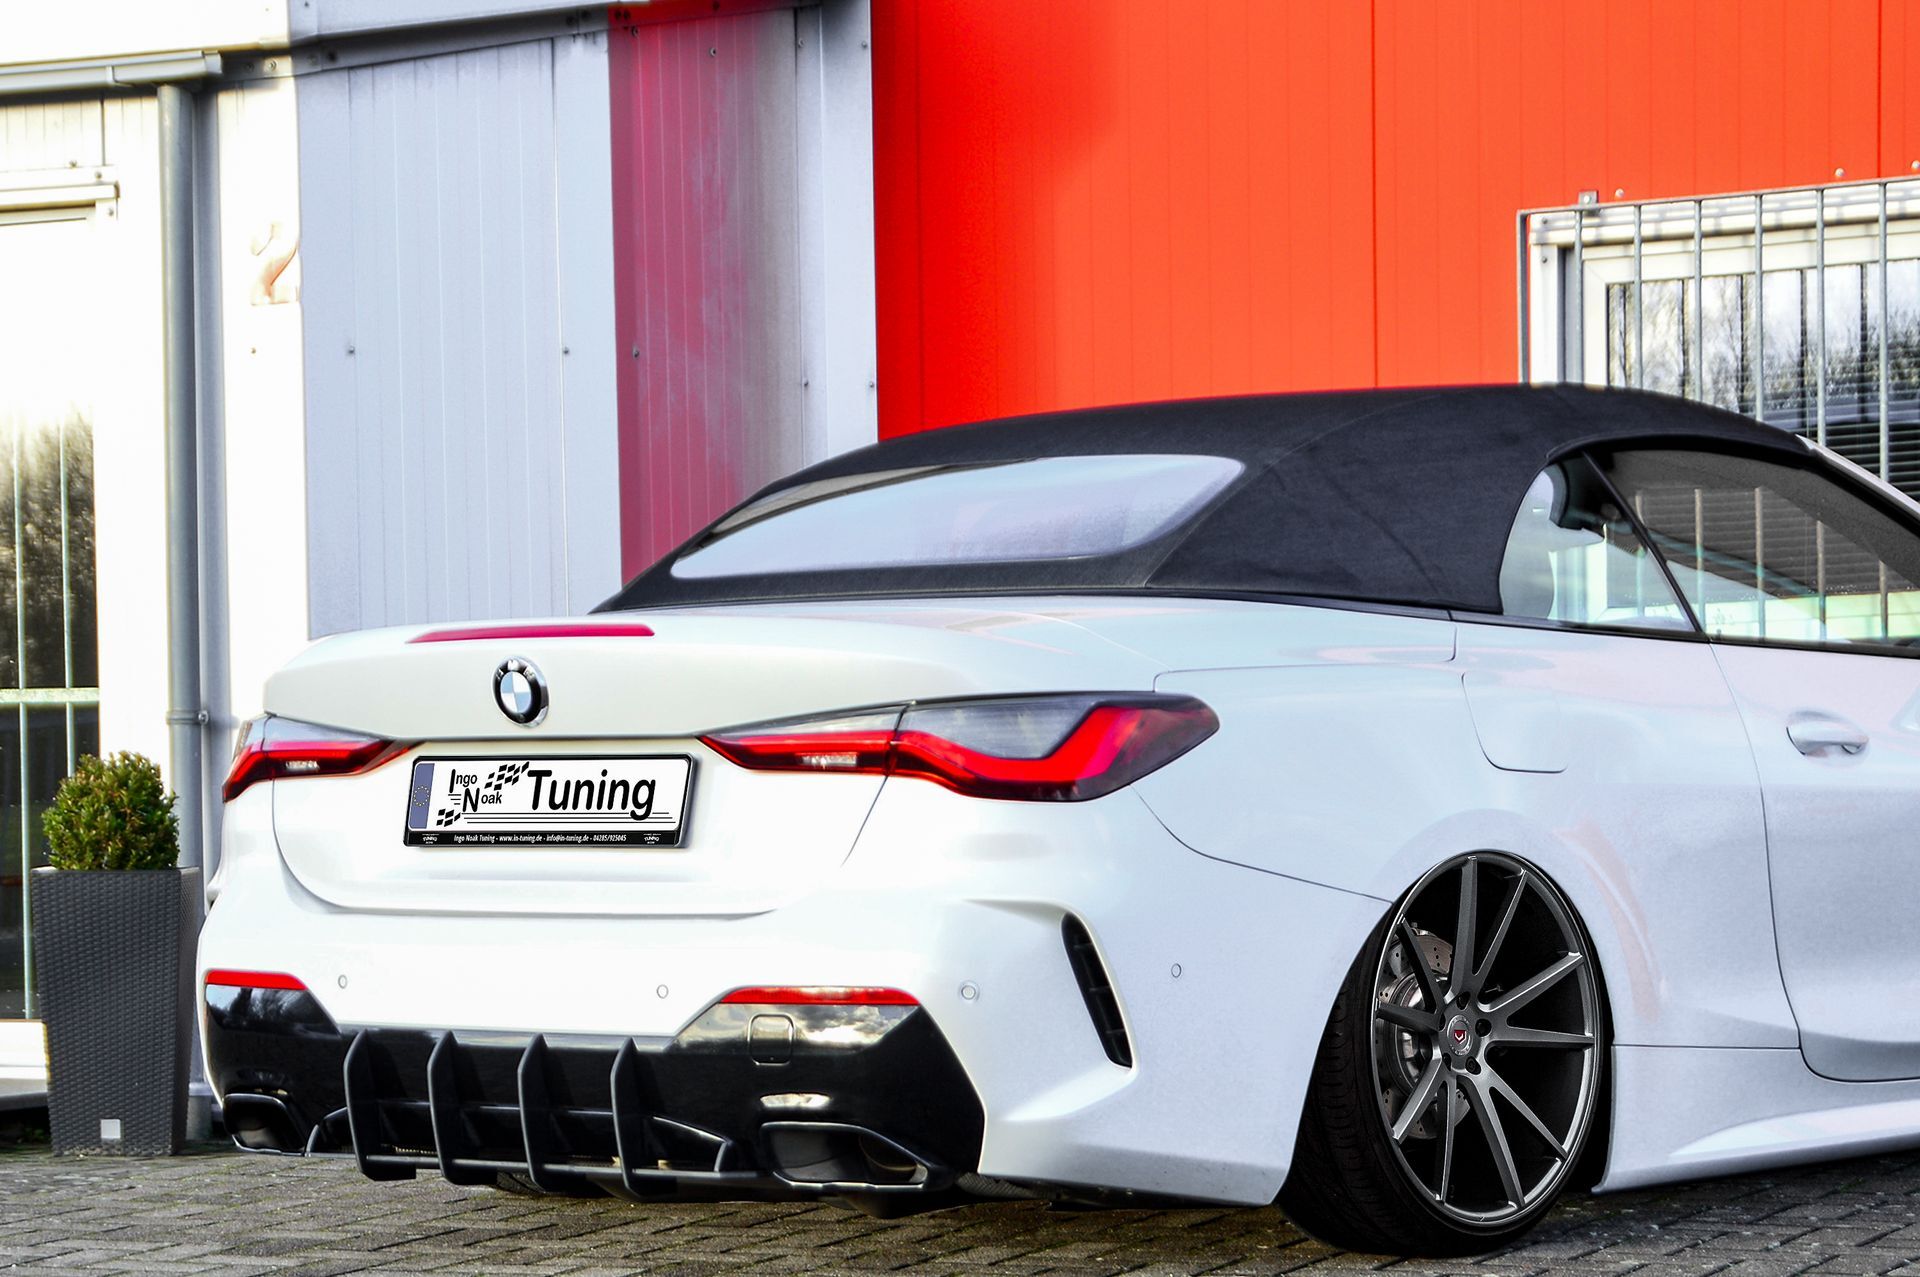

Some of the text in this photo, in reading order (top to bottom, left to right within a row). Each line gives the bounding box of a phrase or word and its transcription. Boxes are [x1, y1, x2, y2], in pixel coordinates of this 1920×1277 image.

[449, 769, 478, 793] Ingo
[462, 788, 502, 812] Noak
[527, 769, 656, 820] Tuning
[453, 834, 465, 843] Ingo
[465, 834, 478, 842] Noak
[479, 834, 495, 843] Tuning
